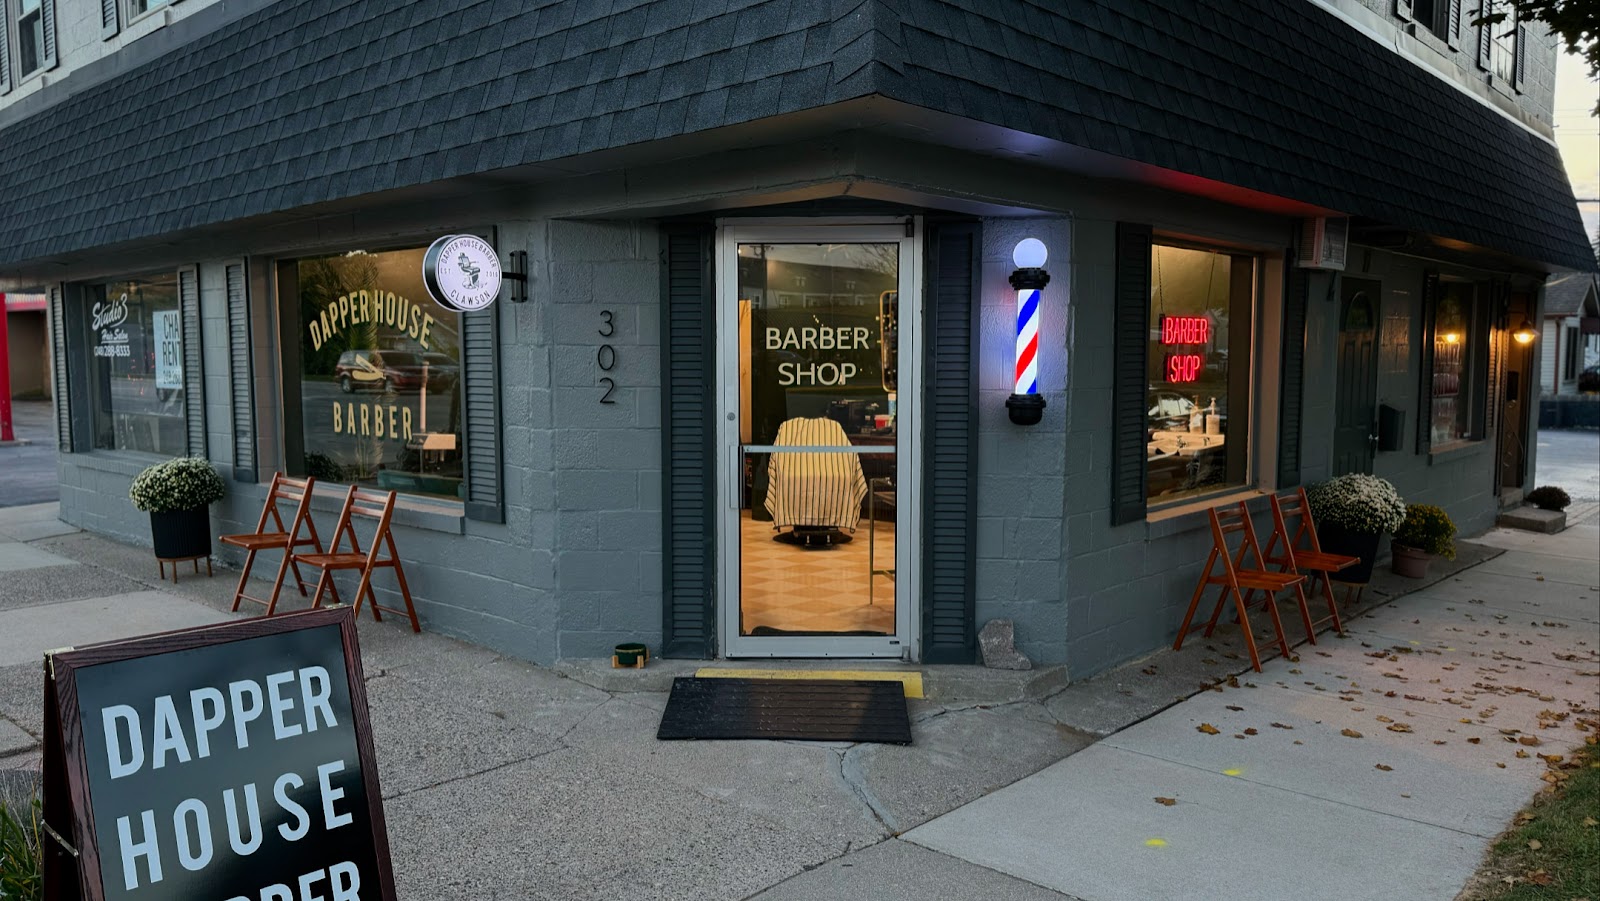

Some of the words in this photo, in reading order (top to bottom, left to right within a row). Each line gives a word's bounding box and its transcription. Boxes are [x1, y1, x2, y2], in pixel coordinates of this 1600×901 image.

[440, 243, 459, 264] DAPPER
[459, 239, 478, 250] HOUSE
[478, 244, 497, 268] BARBER
[450, 289, 491, 306] CLAWSON
[92, 300, 122, 331] Studio
[309, 289, 370, 352] DAPPER
[374, 289, 434, 350] HOUSE
[766, 327, 870, 350] BARBER
[1165, 317, 1208, 344] BARBER
[778, 362, 857, 386] SHOP
[1170, 355, 1200, 383] SHOP
[333, 402, 413, 441] BARBER
[102, 666, 338, 779] DAPPER
[116, 760, 353, 891] HOUSE
